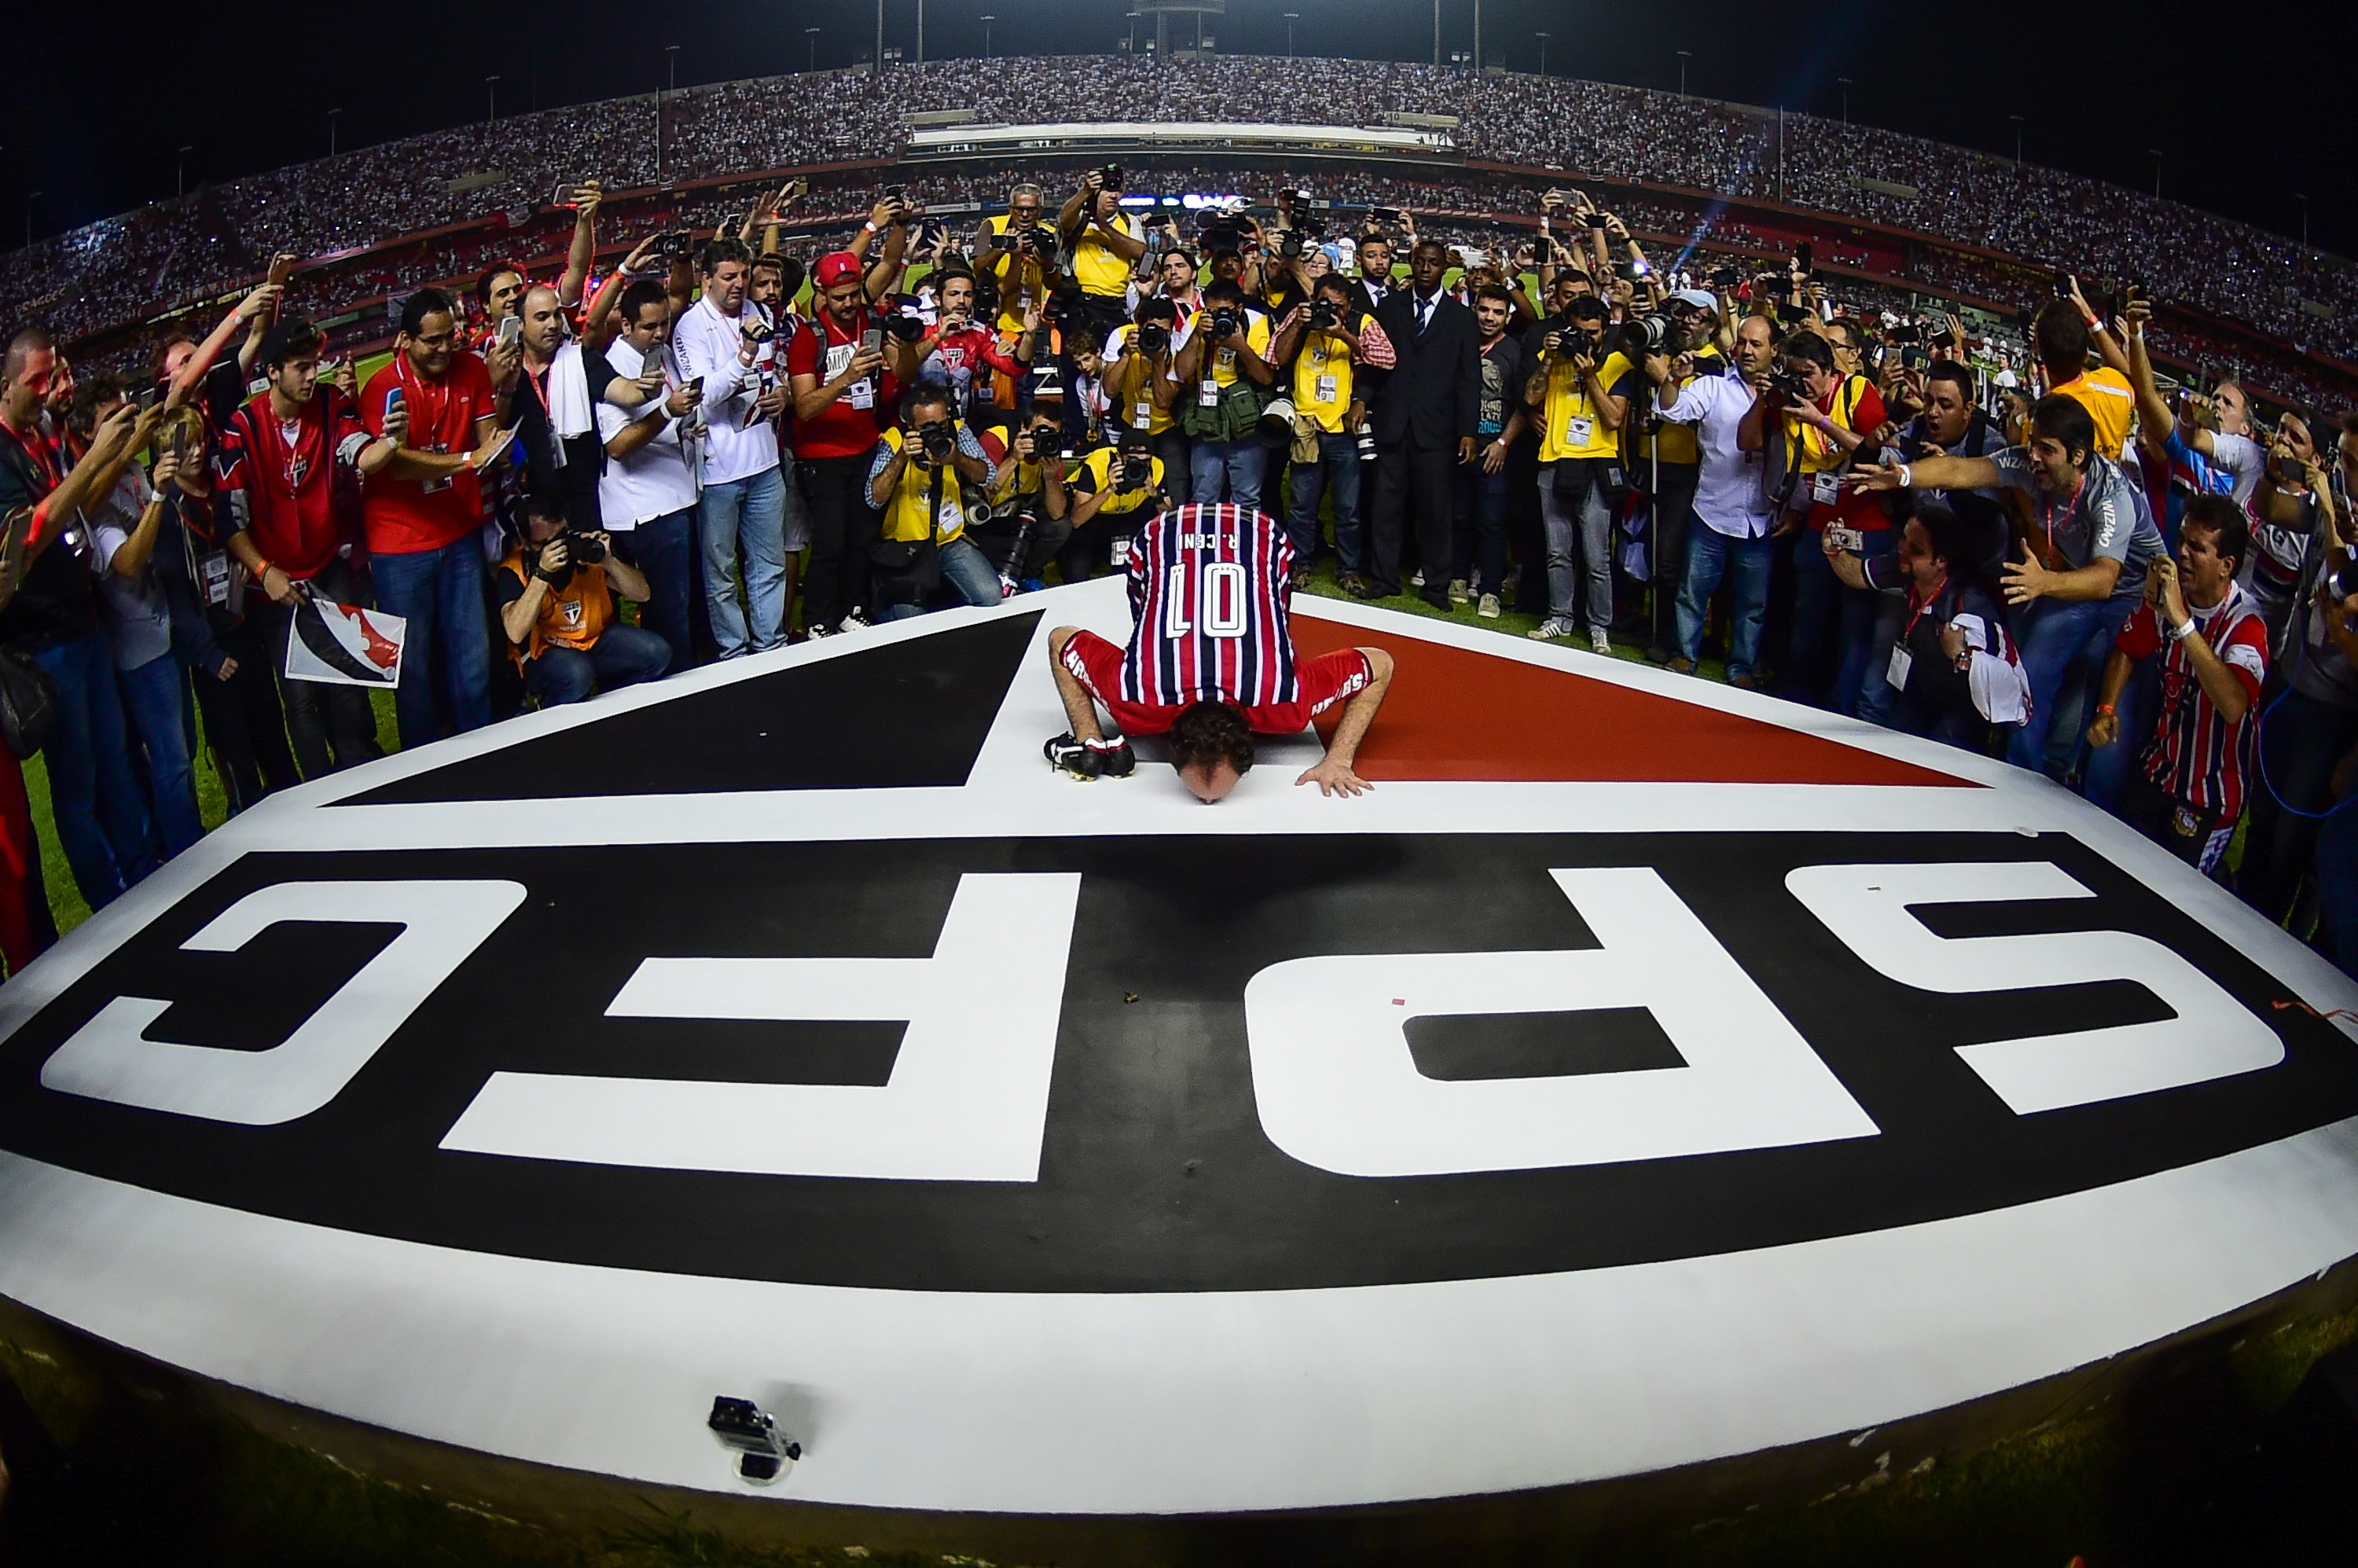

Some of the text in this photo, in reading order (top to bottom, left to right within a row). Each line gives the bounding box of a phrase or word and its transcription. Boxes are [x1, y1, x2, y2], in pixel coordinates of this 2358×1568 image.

[1388, 112, 1400, 121] 10
[1178, 533, 1217, 550] CENI
[40, 861, 2286, 1184] SPFC
